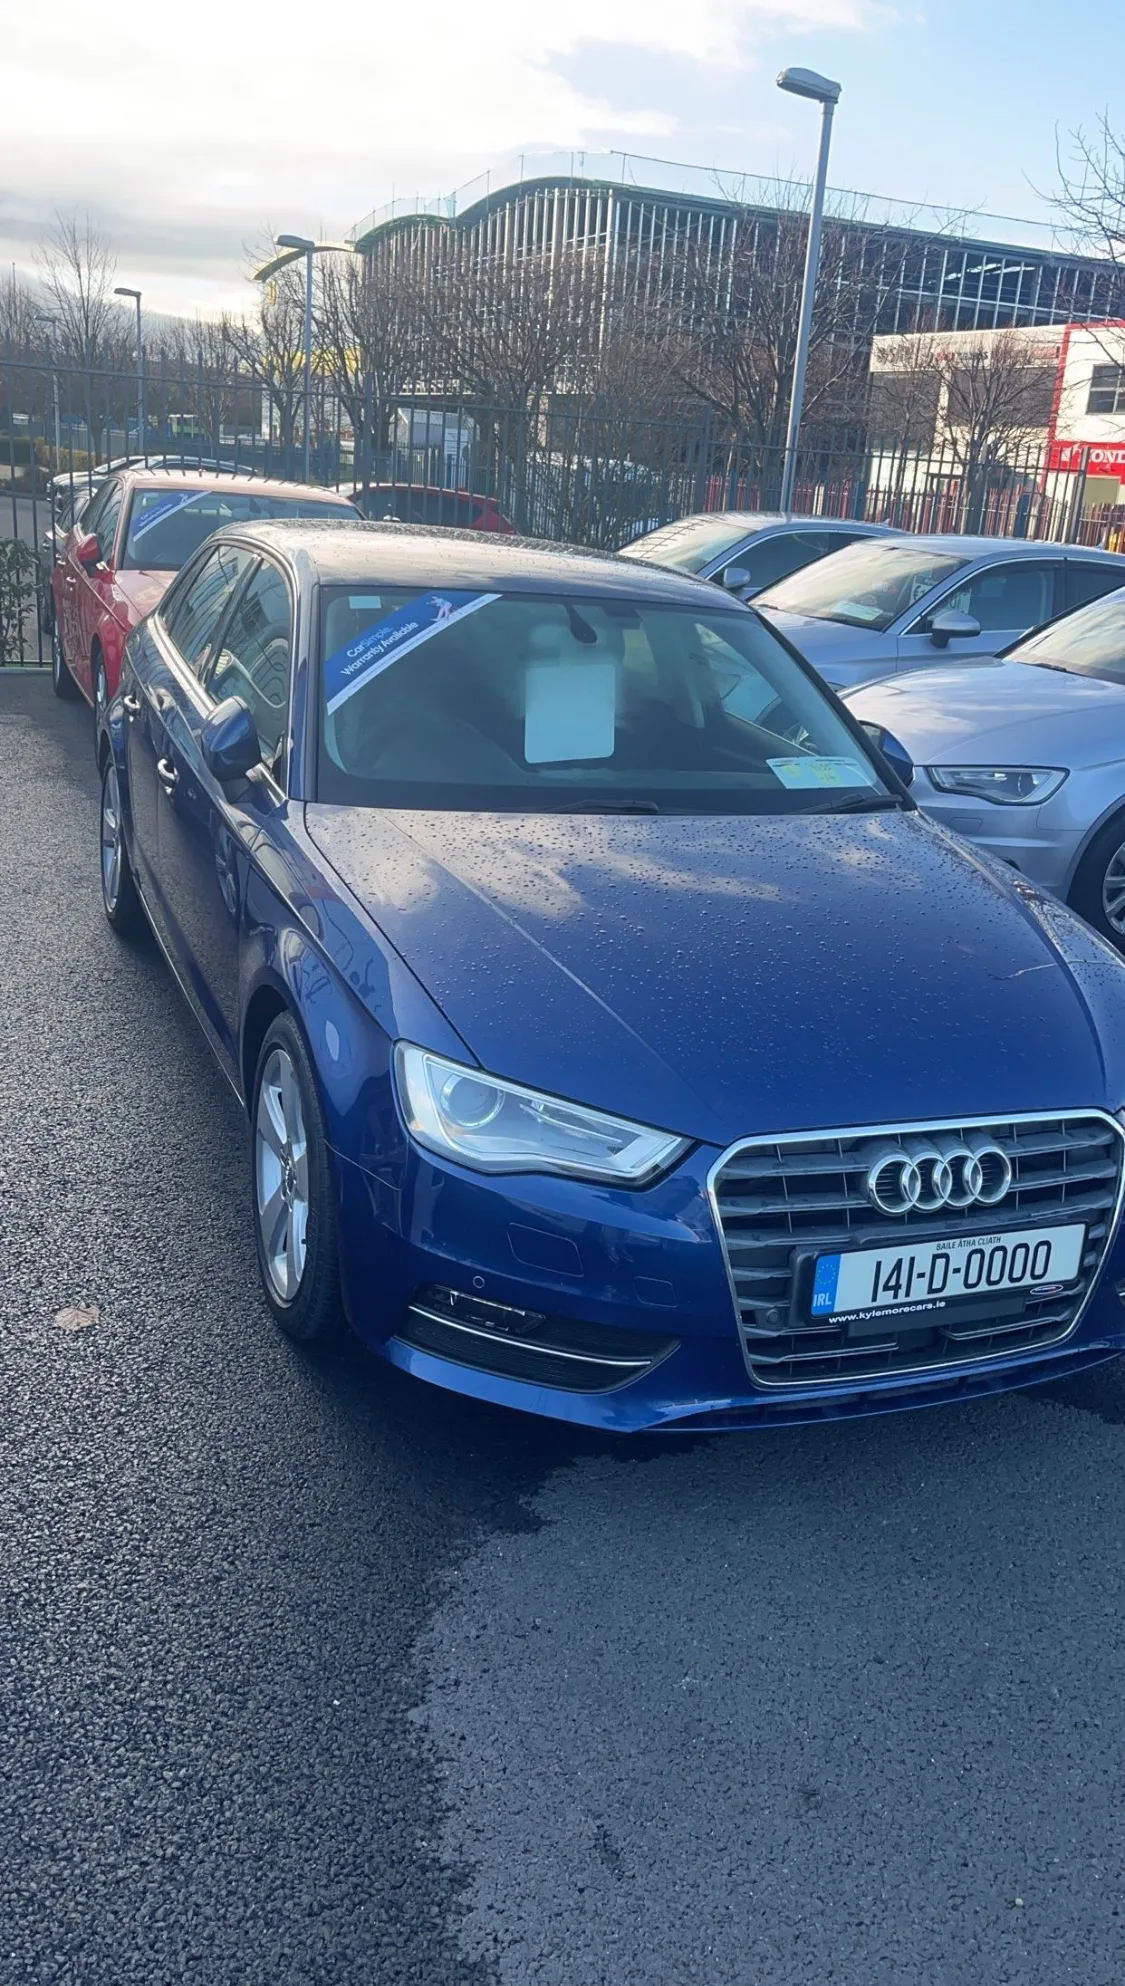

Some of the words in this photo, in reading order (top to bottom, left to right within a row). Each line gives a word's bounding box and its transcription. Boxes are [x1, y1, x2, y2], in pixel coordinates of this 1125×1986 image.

[340, 644, 384, 675] Warranty
[381, 622, 419, 648] Available
[936, 1242, 956, 1251] BAILE
[977, 1236, 1002, 1246] CLIATH
[871, 1240, 1052, 1302] 141-D-0000
[813, 1294, 832, 1307] IRL
[828, 1300, 946, 1324] www.kylemorecars.ie
